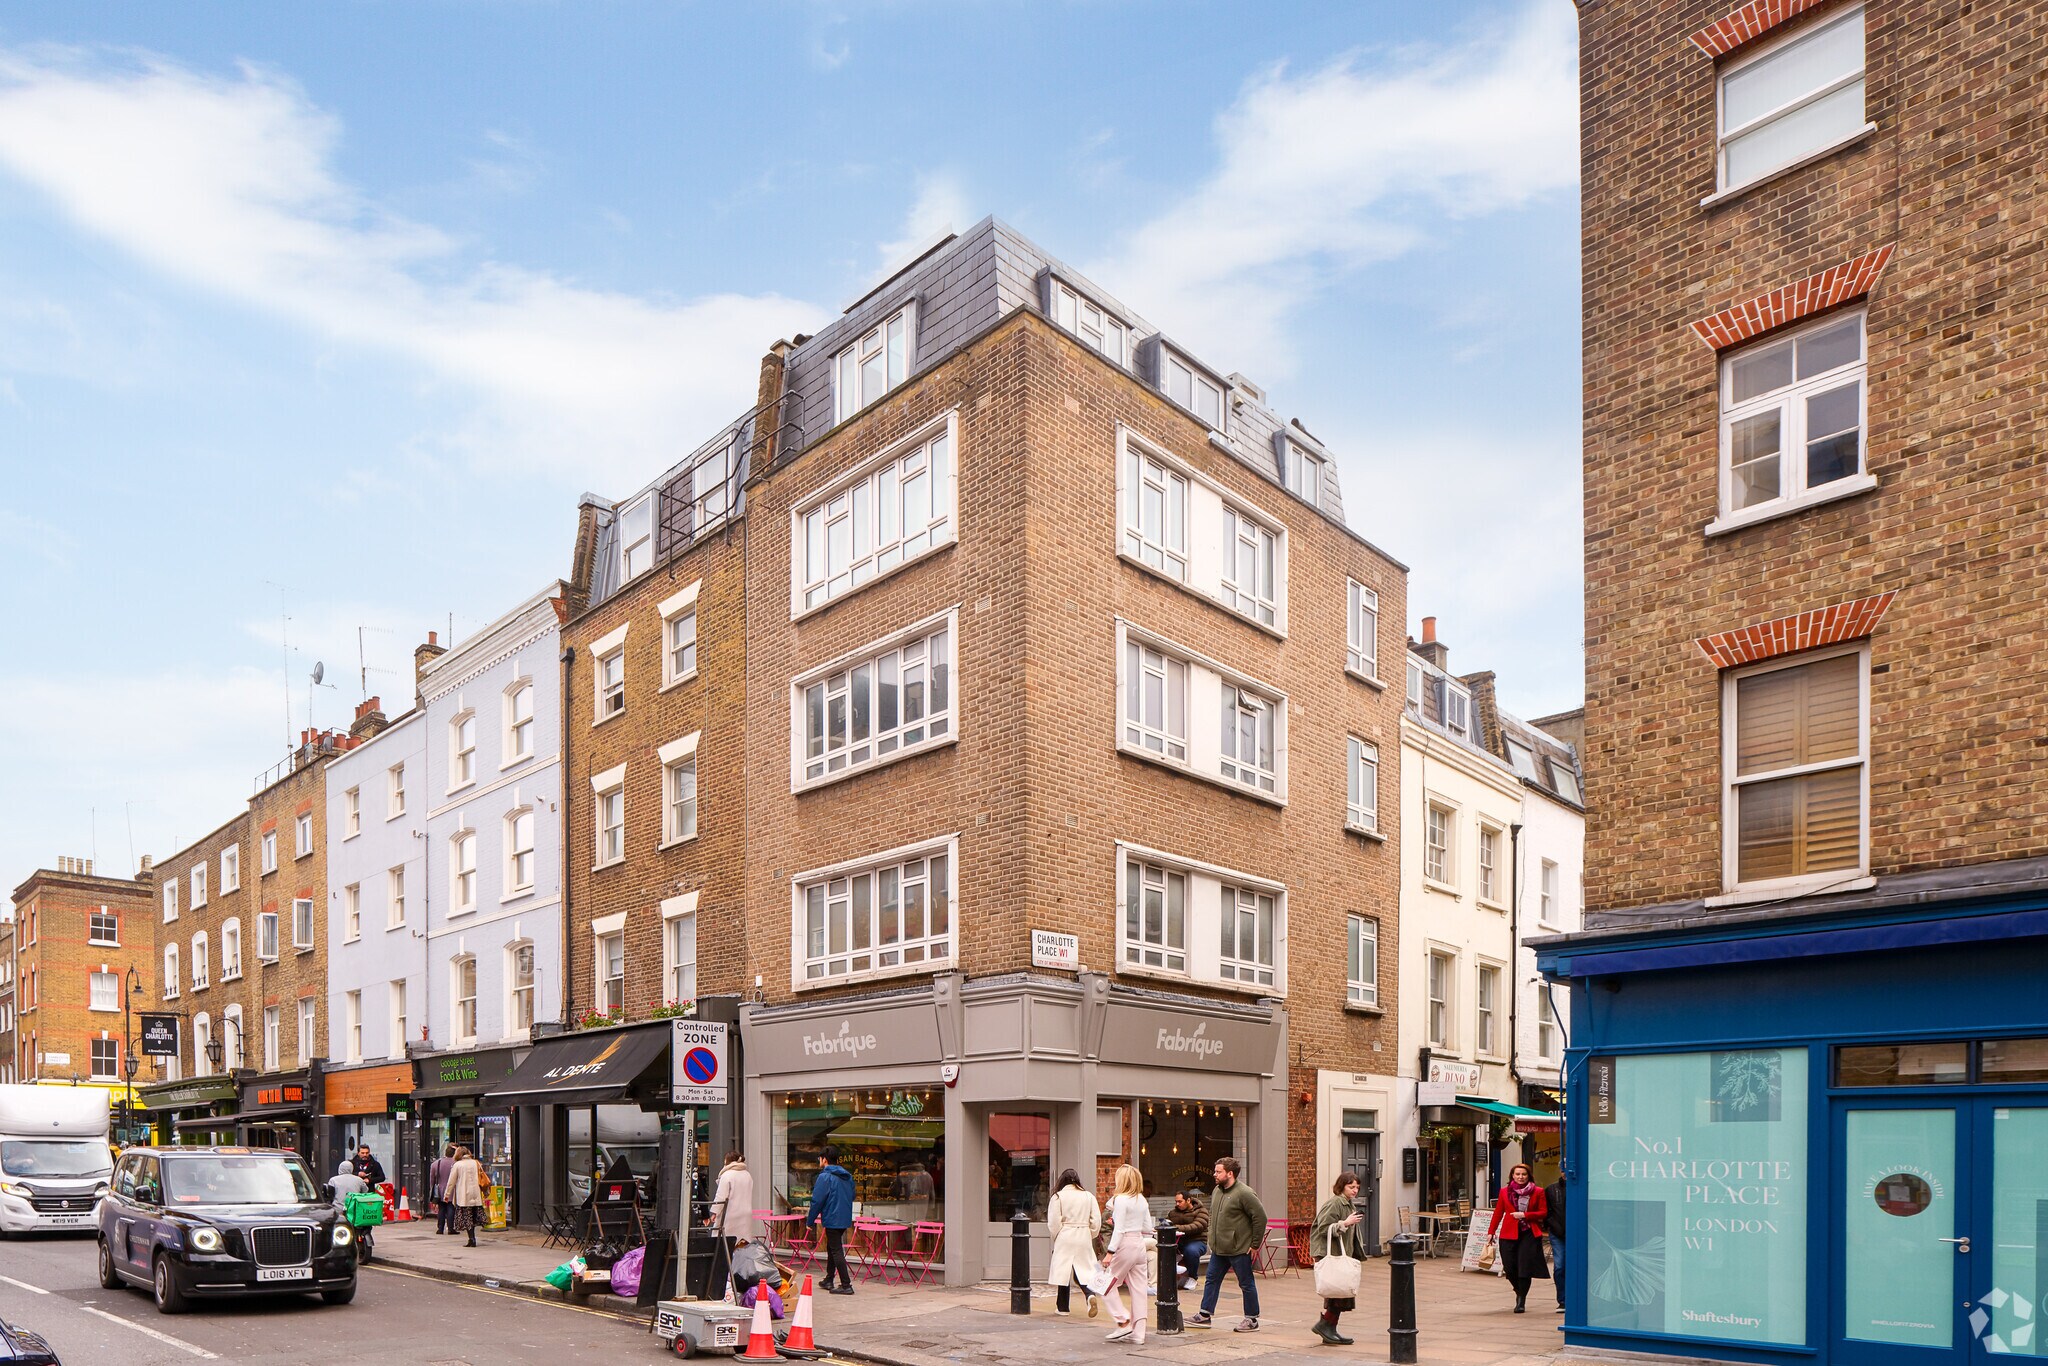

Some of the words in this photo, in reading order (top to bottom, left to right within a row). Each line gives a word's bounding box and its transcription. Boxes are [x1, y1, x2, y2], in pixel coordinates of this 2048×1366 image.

[1037, 933, 1074, 948] CHARLOTTE
[1037, 945, 1057, 957] PLACE
[1058, 948, 1068, 958] W1
[676, 1022, 725, 1033] Controlled
[683, 1033, 718, 1045] ZONE
[803, 1020, 877, 1058] Fabrique
[1156, 1021, 1224, 1060] Fabrique
[440, 1058, 460, 1069] Goodge
[460, 1056, 476, 1066] Street
[543, 1067, 562, 1078] AL
[561, 1062, 607, 1077] DENTE
[440, 1069, 455, 1082] Food
[455, 1069, 461, 1080] &
[461, 1068, 478, 1080] Wine
[1444, 1072, 1466, 1085] DINO
[284, 1087, 302, 1096] WOK
[854, 1154, 884, 1171] BAKERY
[1608, 1160, 1792, 1180] CHARLOTTE
[1887, 1164, 1920, 1174] LOOK
[1922, 1170, 1945, 1199] INSIDE
[1685, 1185, 1780, 1206] PLACE
[1684, 1217, 1779, 1234] LONDON
[1684, 1236, 1713, 1251] W1
[263, 1270, 280, 1280] LO18
[287, 1269, 307, 1278] XFV
[660, 1312, 682, 1328] SRL
[1681, 1309, 1762, 1329] Shaftesbury
[716, 1326, 737, 1334] SRL
